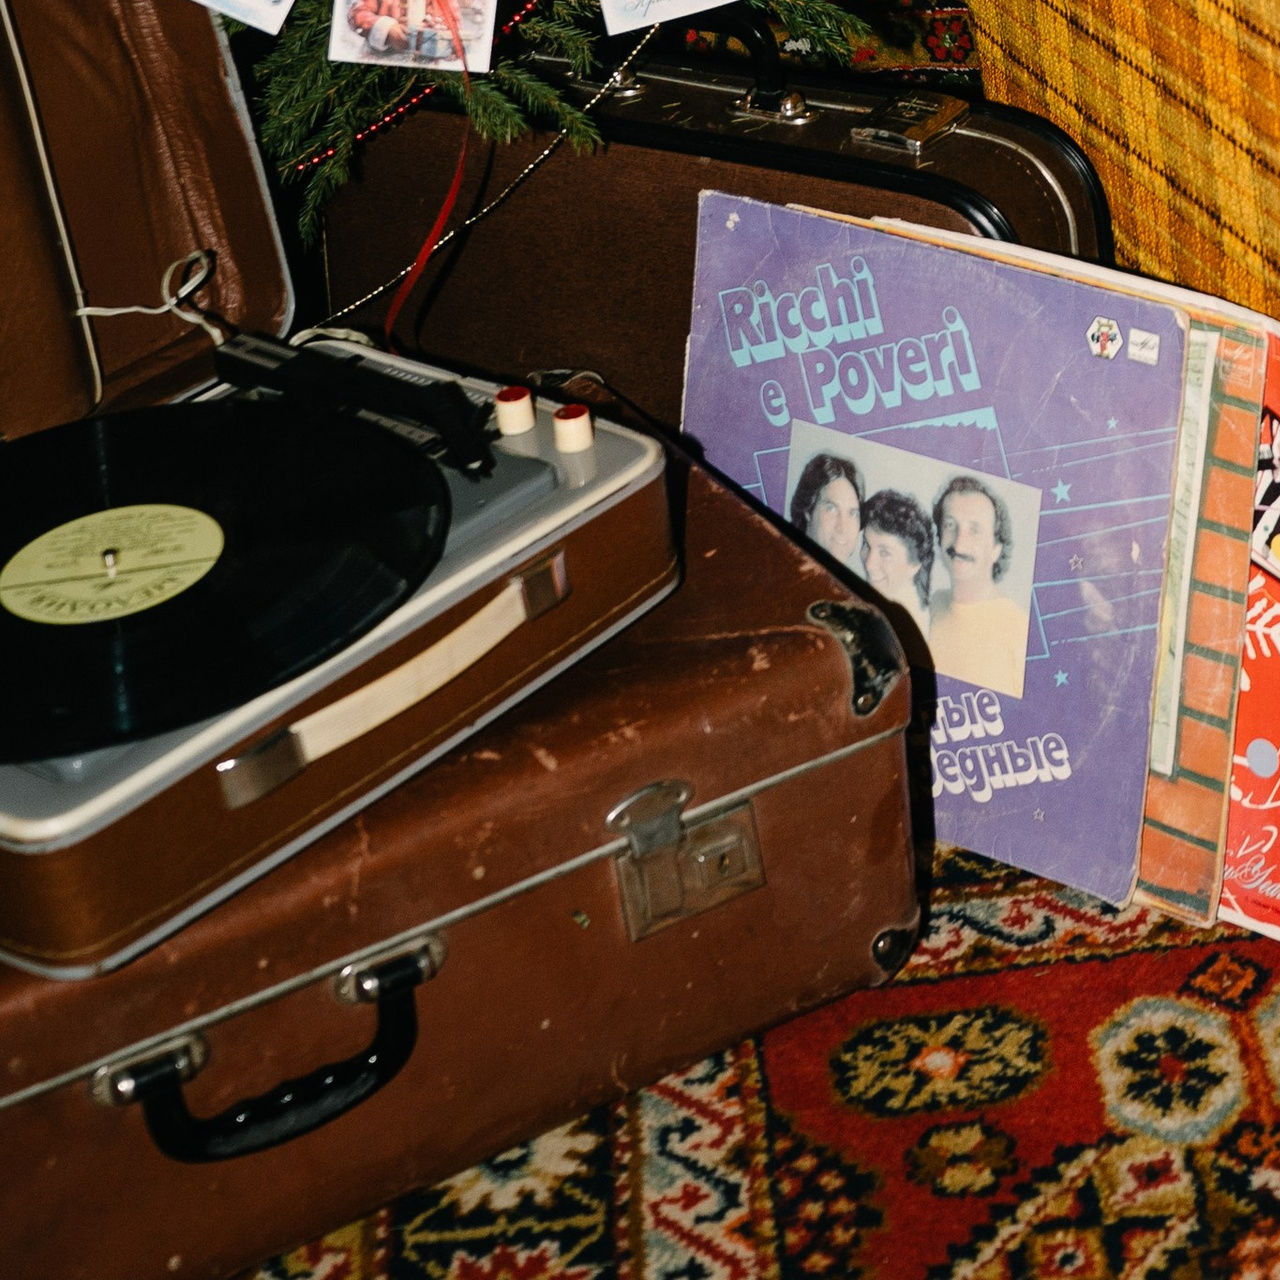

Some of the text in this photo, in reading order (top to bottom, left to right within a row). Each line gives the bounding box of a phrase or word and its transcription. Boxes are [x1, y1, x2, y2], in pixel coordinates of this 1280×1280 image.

[718, 255, 885, 368] Ricchi
[759, 305, 982, 428] e Poveri
